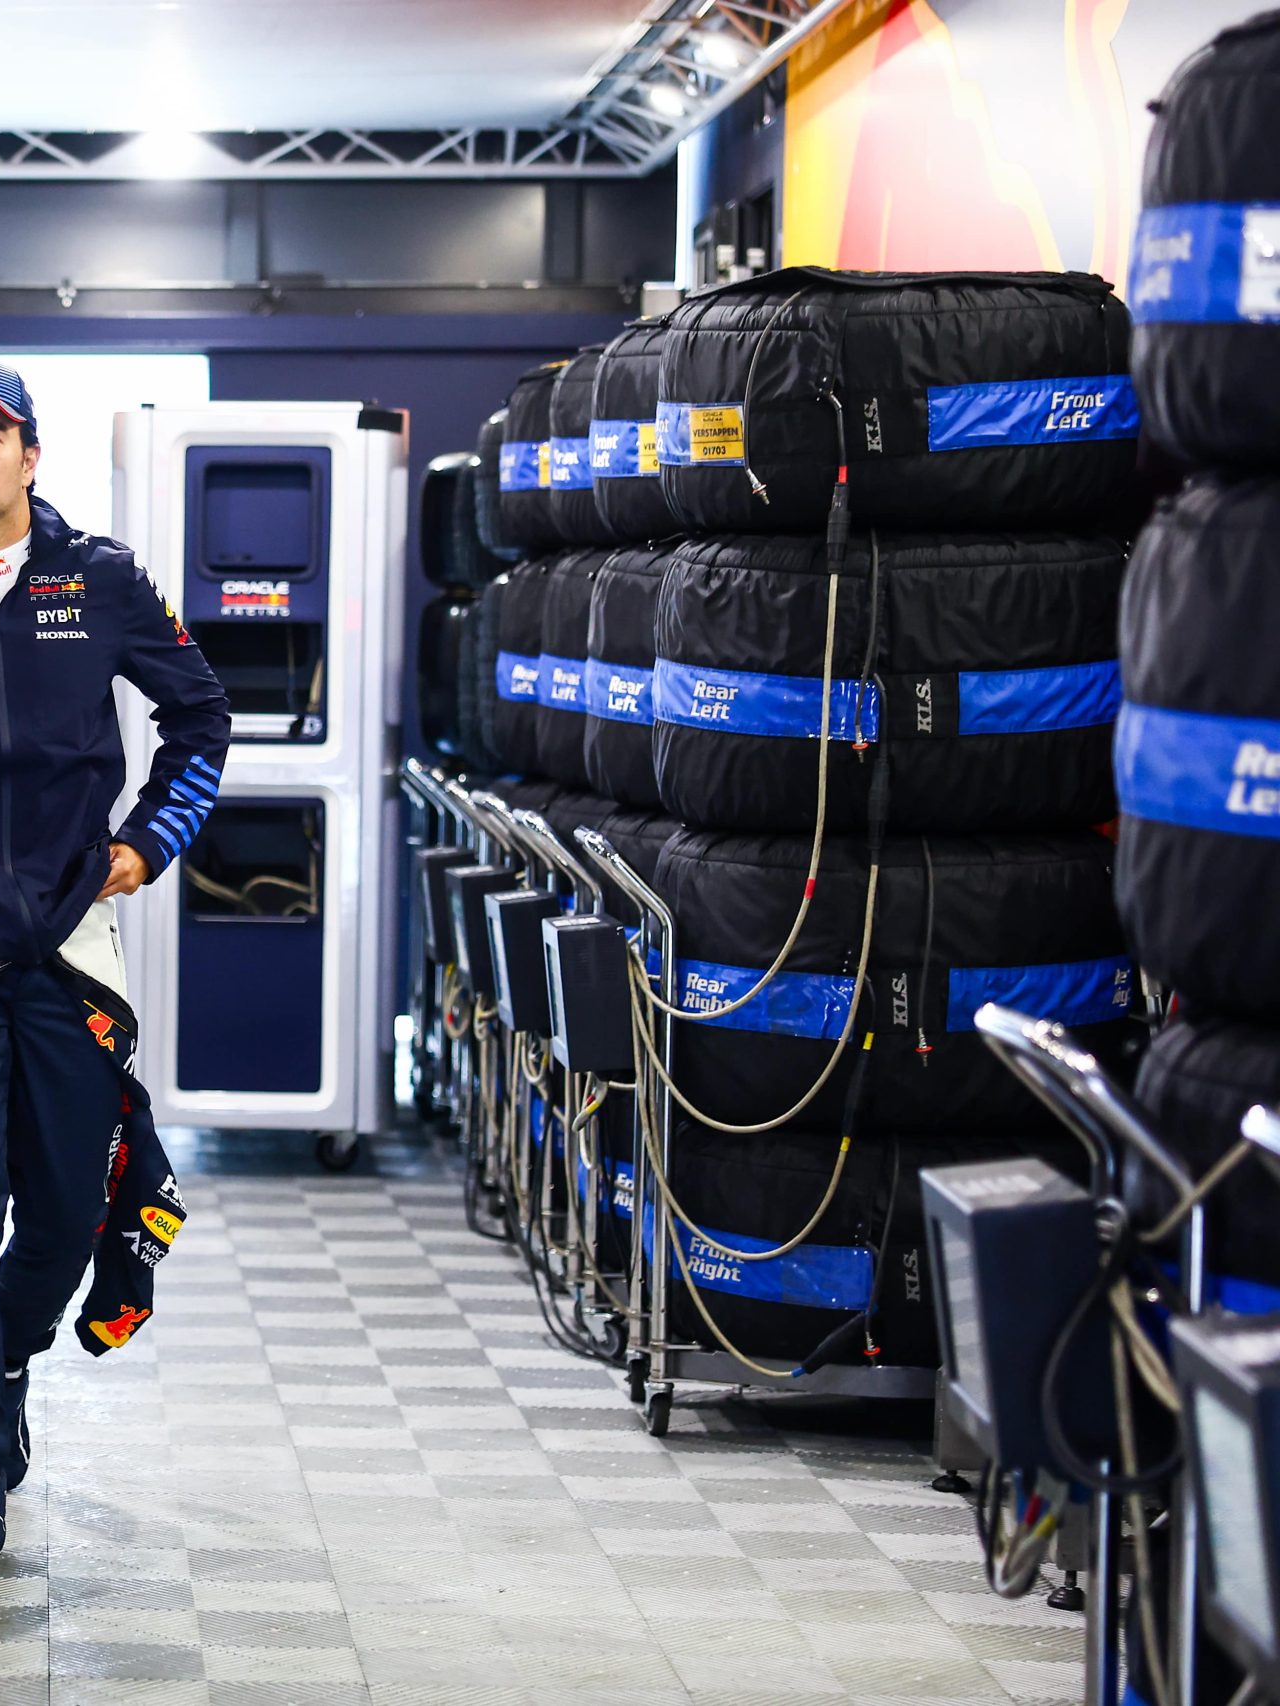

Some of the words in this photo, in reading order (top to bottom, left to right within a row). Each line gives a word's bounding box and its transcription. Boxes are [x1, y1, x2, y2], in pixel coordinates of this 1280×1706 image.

[1050, 390, 1106, 411] Front
[1044, 410, 1091, 431] Left
[693, 427, 738, 438] VERSTAPPEN
[703, 445, 727, 456] 01703
[29, 573, 85, 585] ORACLE
[221, 580, 290, 595] ORACLE
[30, 592, 87, 602] RACING
[36, 606, 82, 624] BYBIT
[35, 630, 90, 641] HONDA
[552, 667, 581, 687] Rear
[608, 675, 645, 697] Rear
[550, 684, 577, 702] Left
[693, 679, 739, 702] Rear
[607, 693, 638, 713] Left
[690, 698, 731, 721] Left
[685, 972, 729, 995] Rear
[687, 1255, 741, 1283] Right
